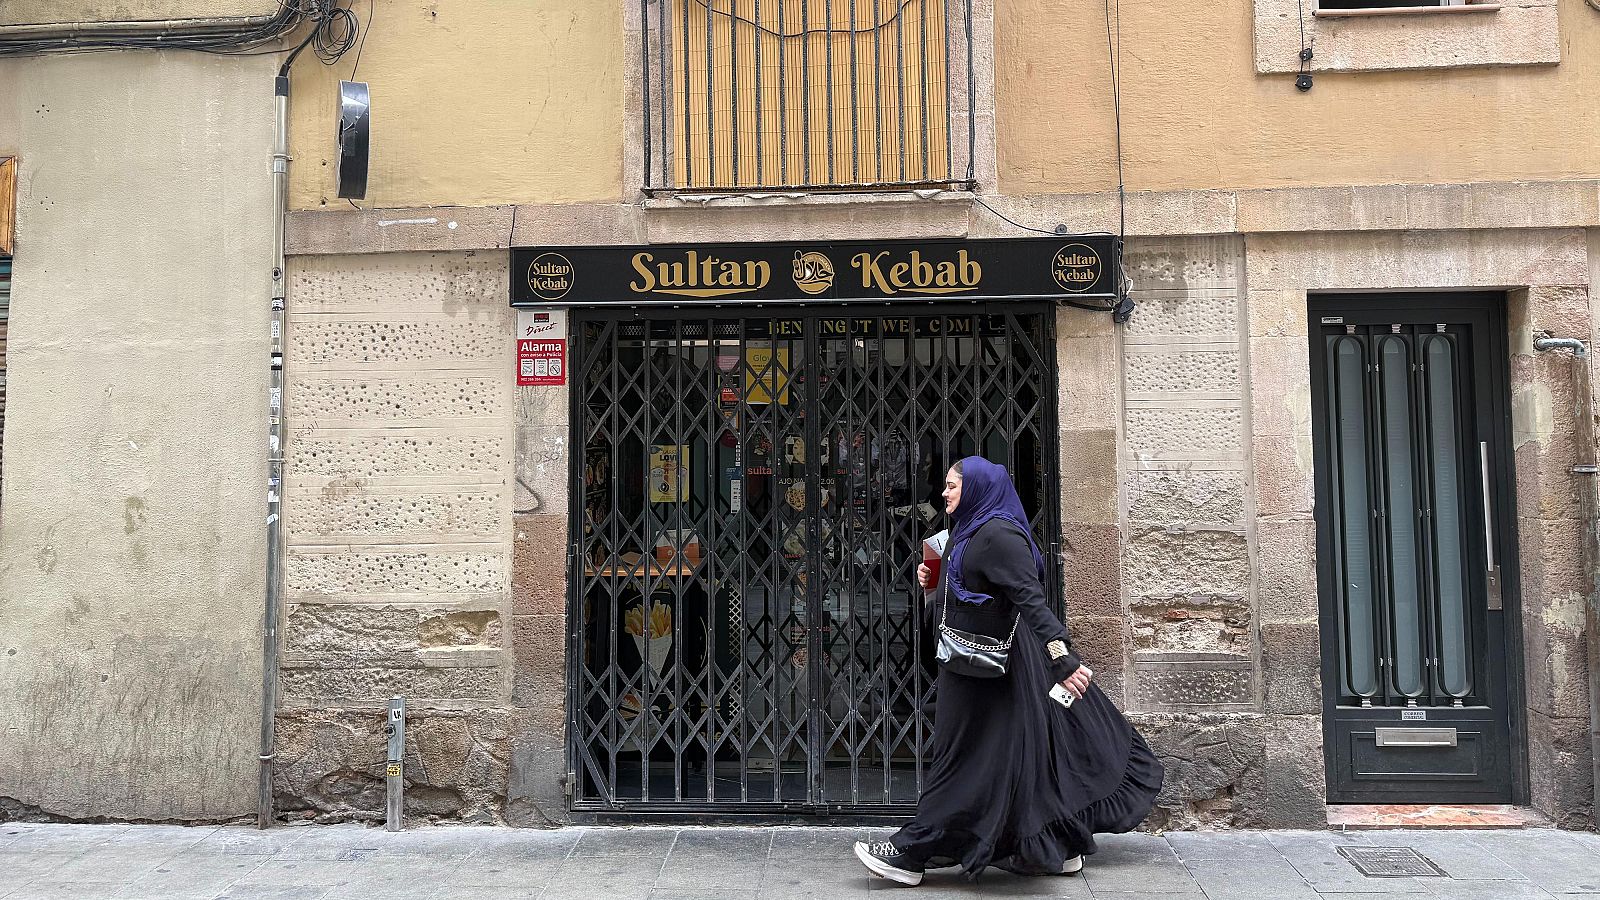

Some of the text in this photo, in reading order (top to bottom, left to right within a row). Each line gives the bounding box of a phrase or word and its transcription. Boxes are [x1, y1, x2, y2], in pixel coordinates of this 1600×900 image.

[1057, 253, 1096, 267] Sultan
[533, 262, 570, 275] Sultan
[630, 250, 982, 294] Sultan Kebab
[1055, 268, 1095, 283] Kebab
[531, 278, 568, 291] Kebab
[526, 322, 557, 337] Direct
[521, 341, 562, 352] Alarma
